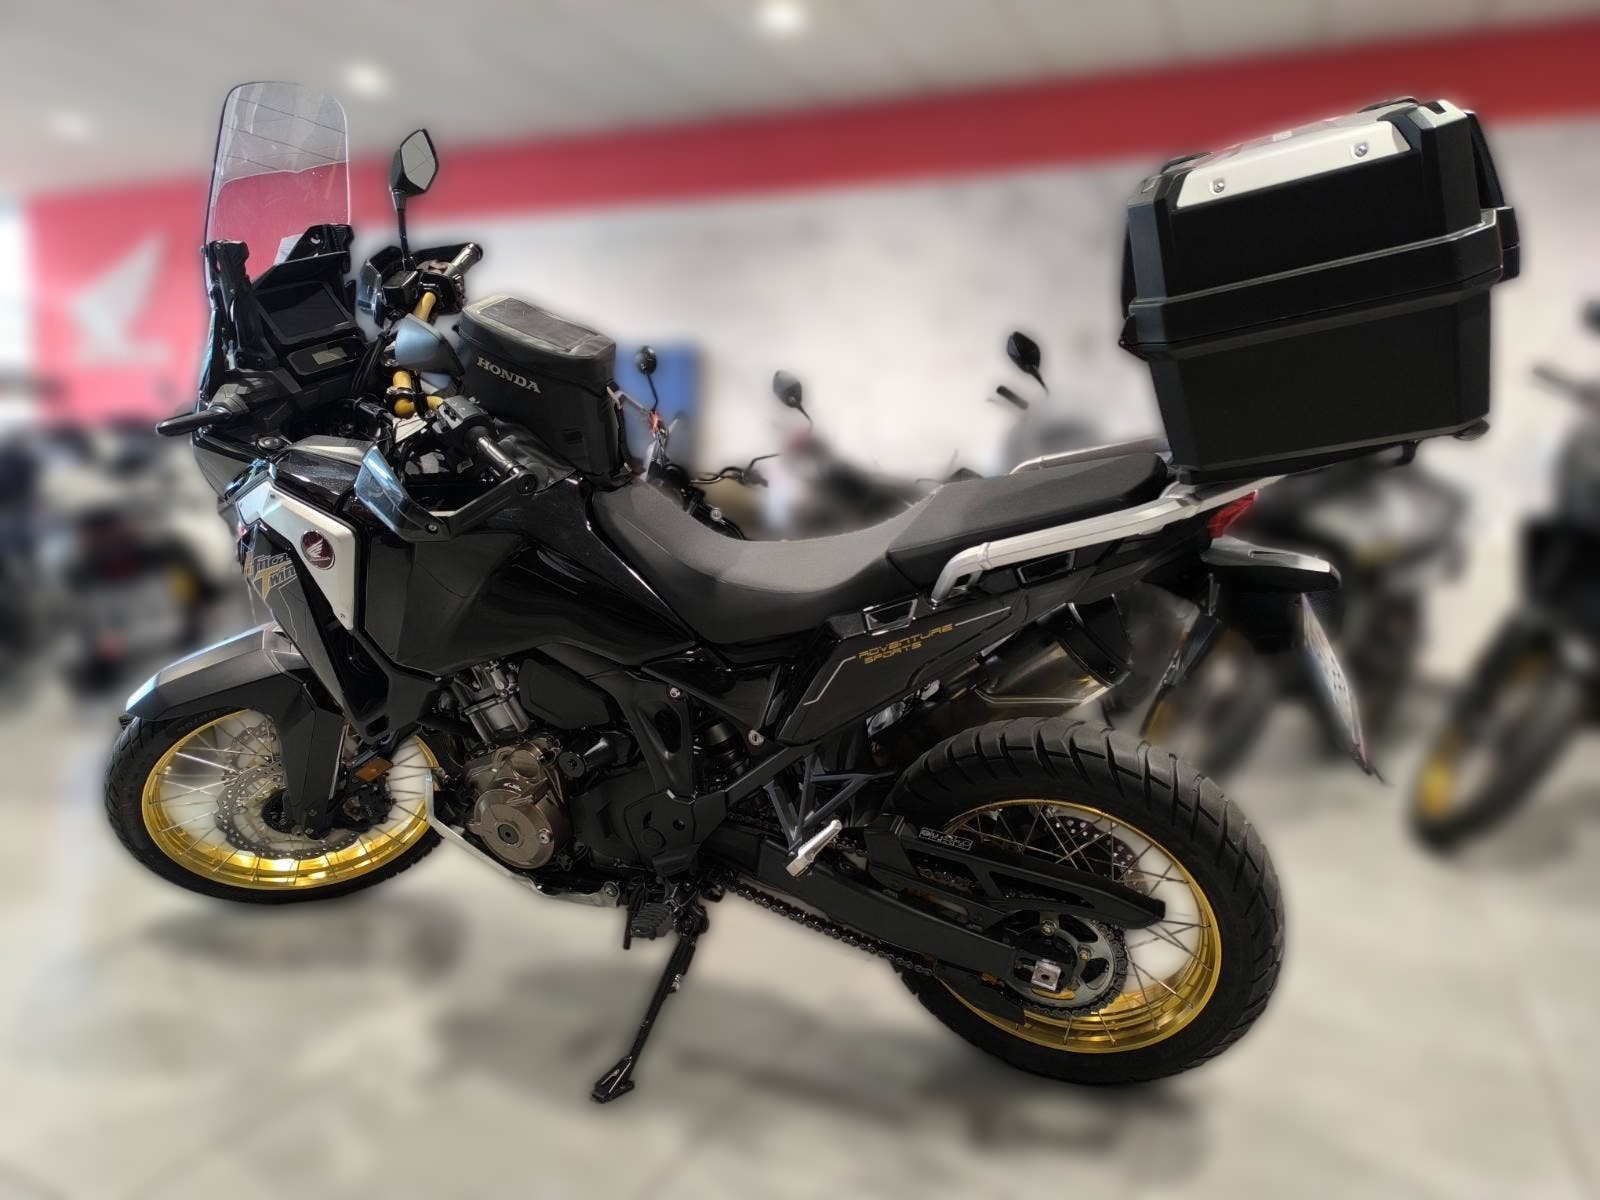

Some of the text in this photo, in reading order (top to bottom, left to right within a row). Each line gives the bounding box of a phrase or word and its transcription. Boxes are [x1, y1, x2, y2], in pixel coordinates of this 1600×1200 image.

[477, 357, 541, 394] HONDA
[858, 624, 954, 660] ADVENTURE
[864, 641, 922, 665] SPORTS
